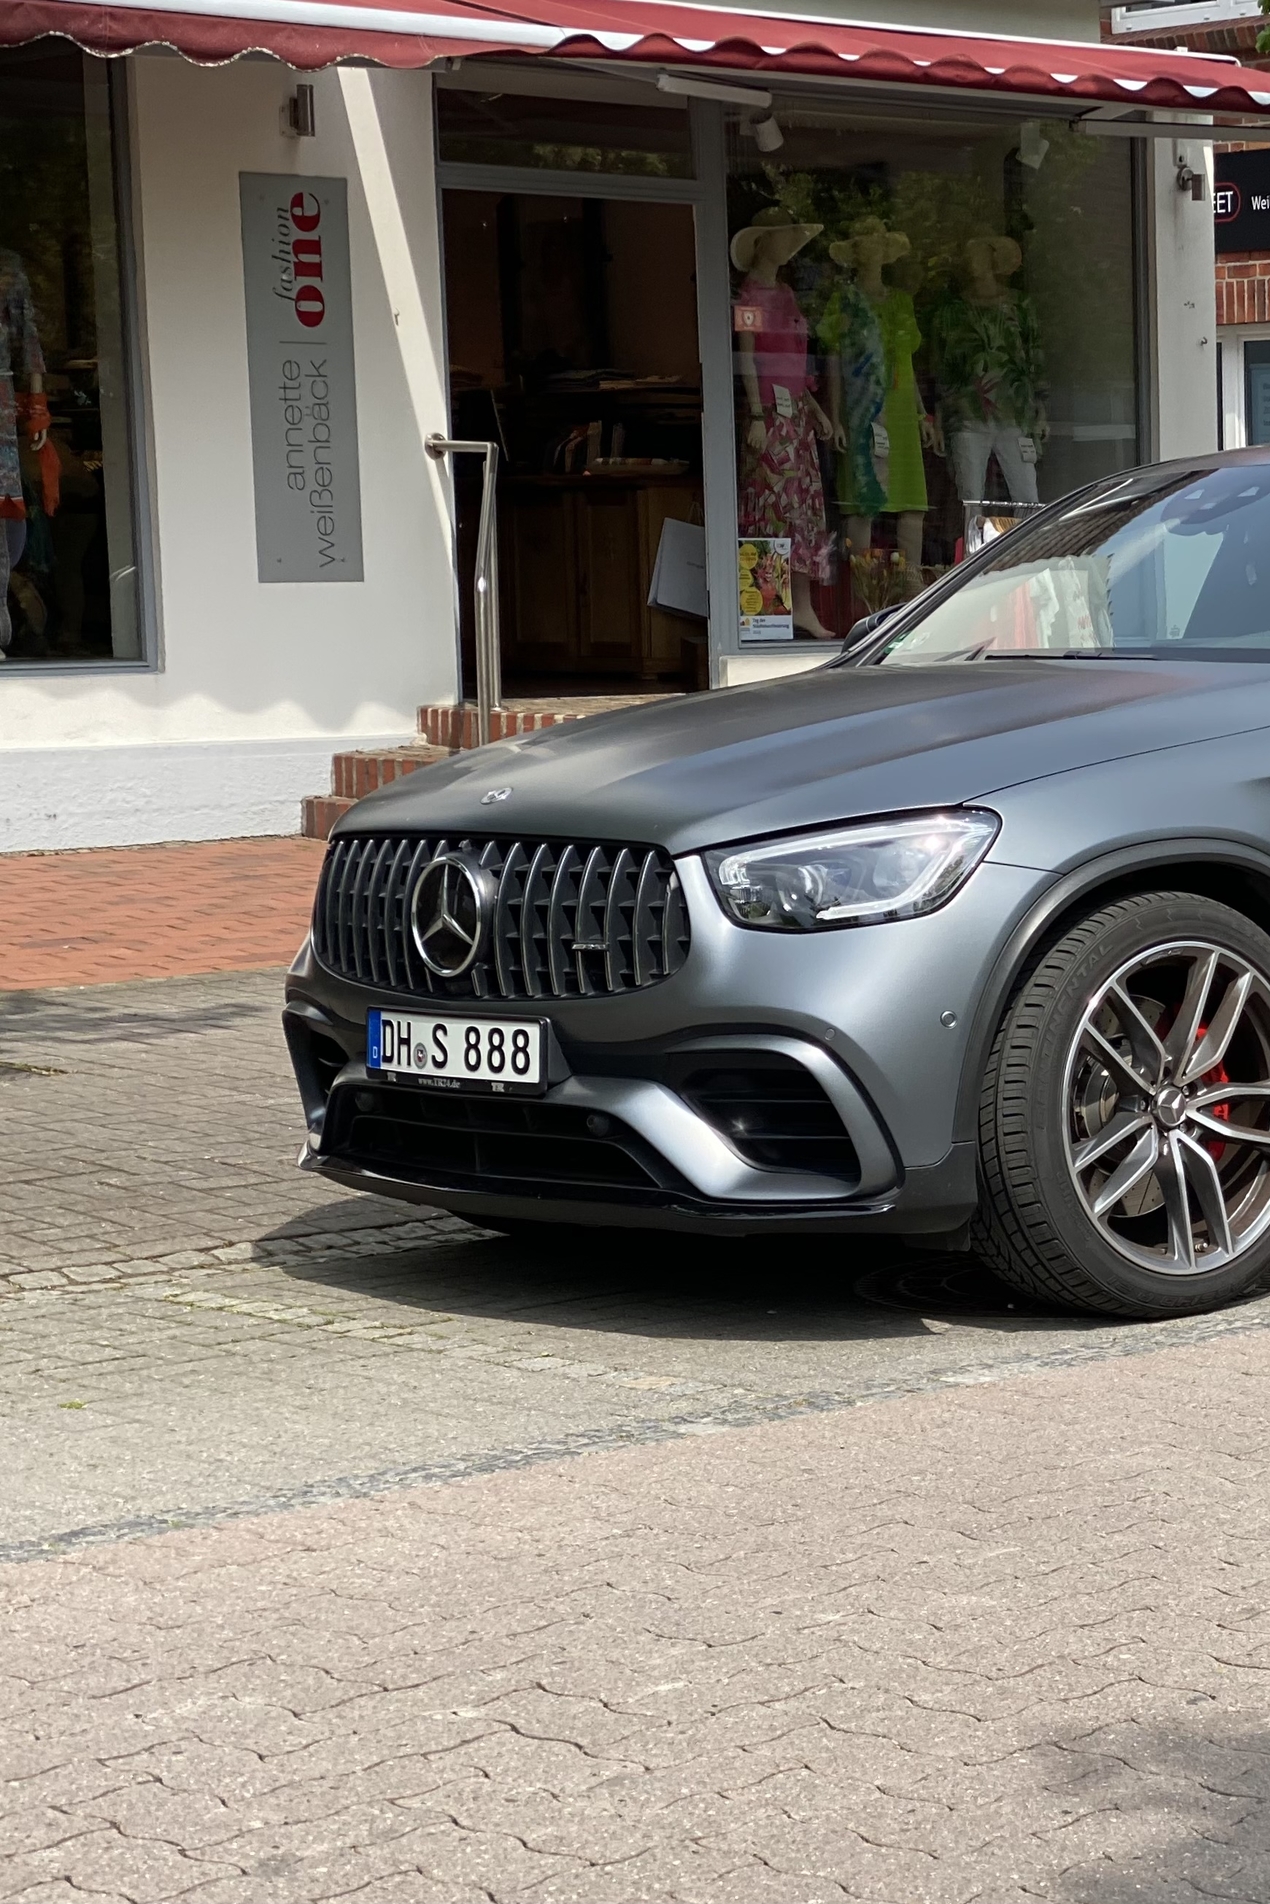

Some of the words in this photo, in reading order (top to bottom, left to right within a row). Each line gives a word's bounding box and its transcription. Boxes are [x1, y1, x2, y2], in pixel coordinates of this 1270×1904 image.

[271, 205, 297, 303] fashion
[290, 191, 326, 328] one
[278, 359, 306, 491] annette
[304, 358, 337, 568] weißenbäck
[381, 1019, 412, 1067] DH
[431, 1023, 449, 1069] S
[464, 1026, 531, 1076] 888
